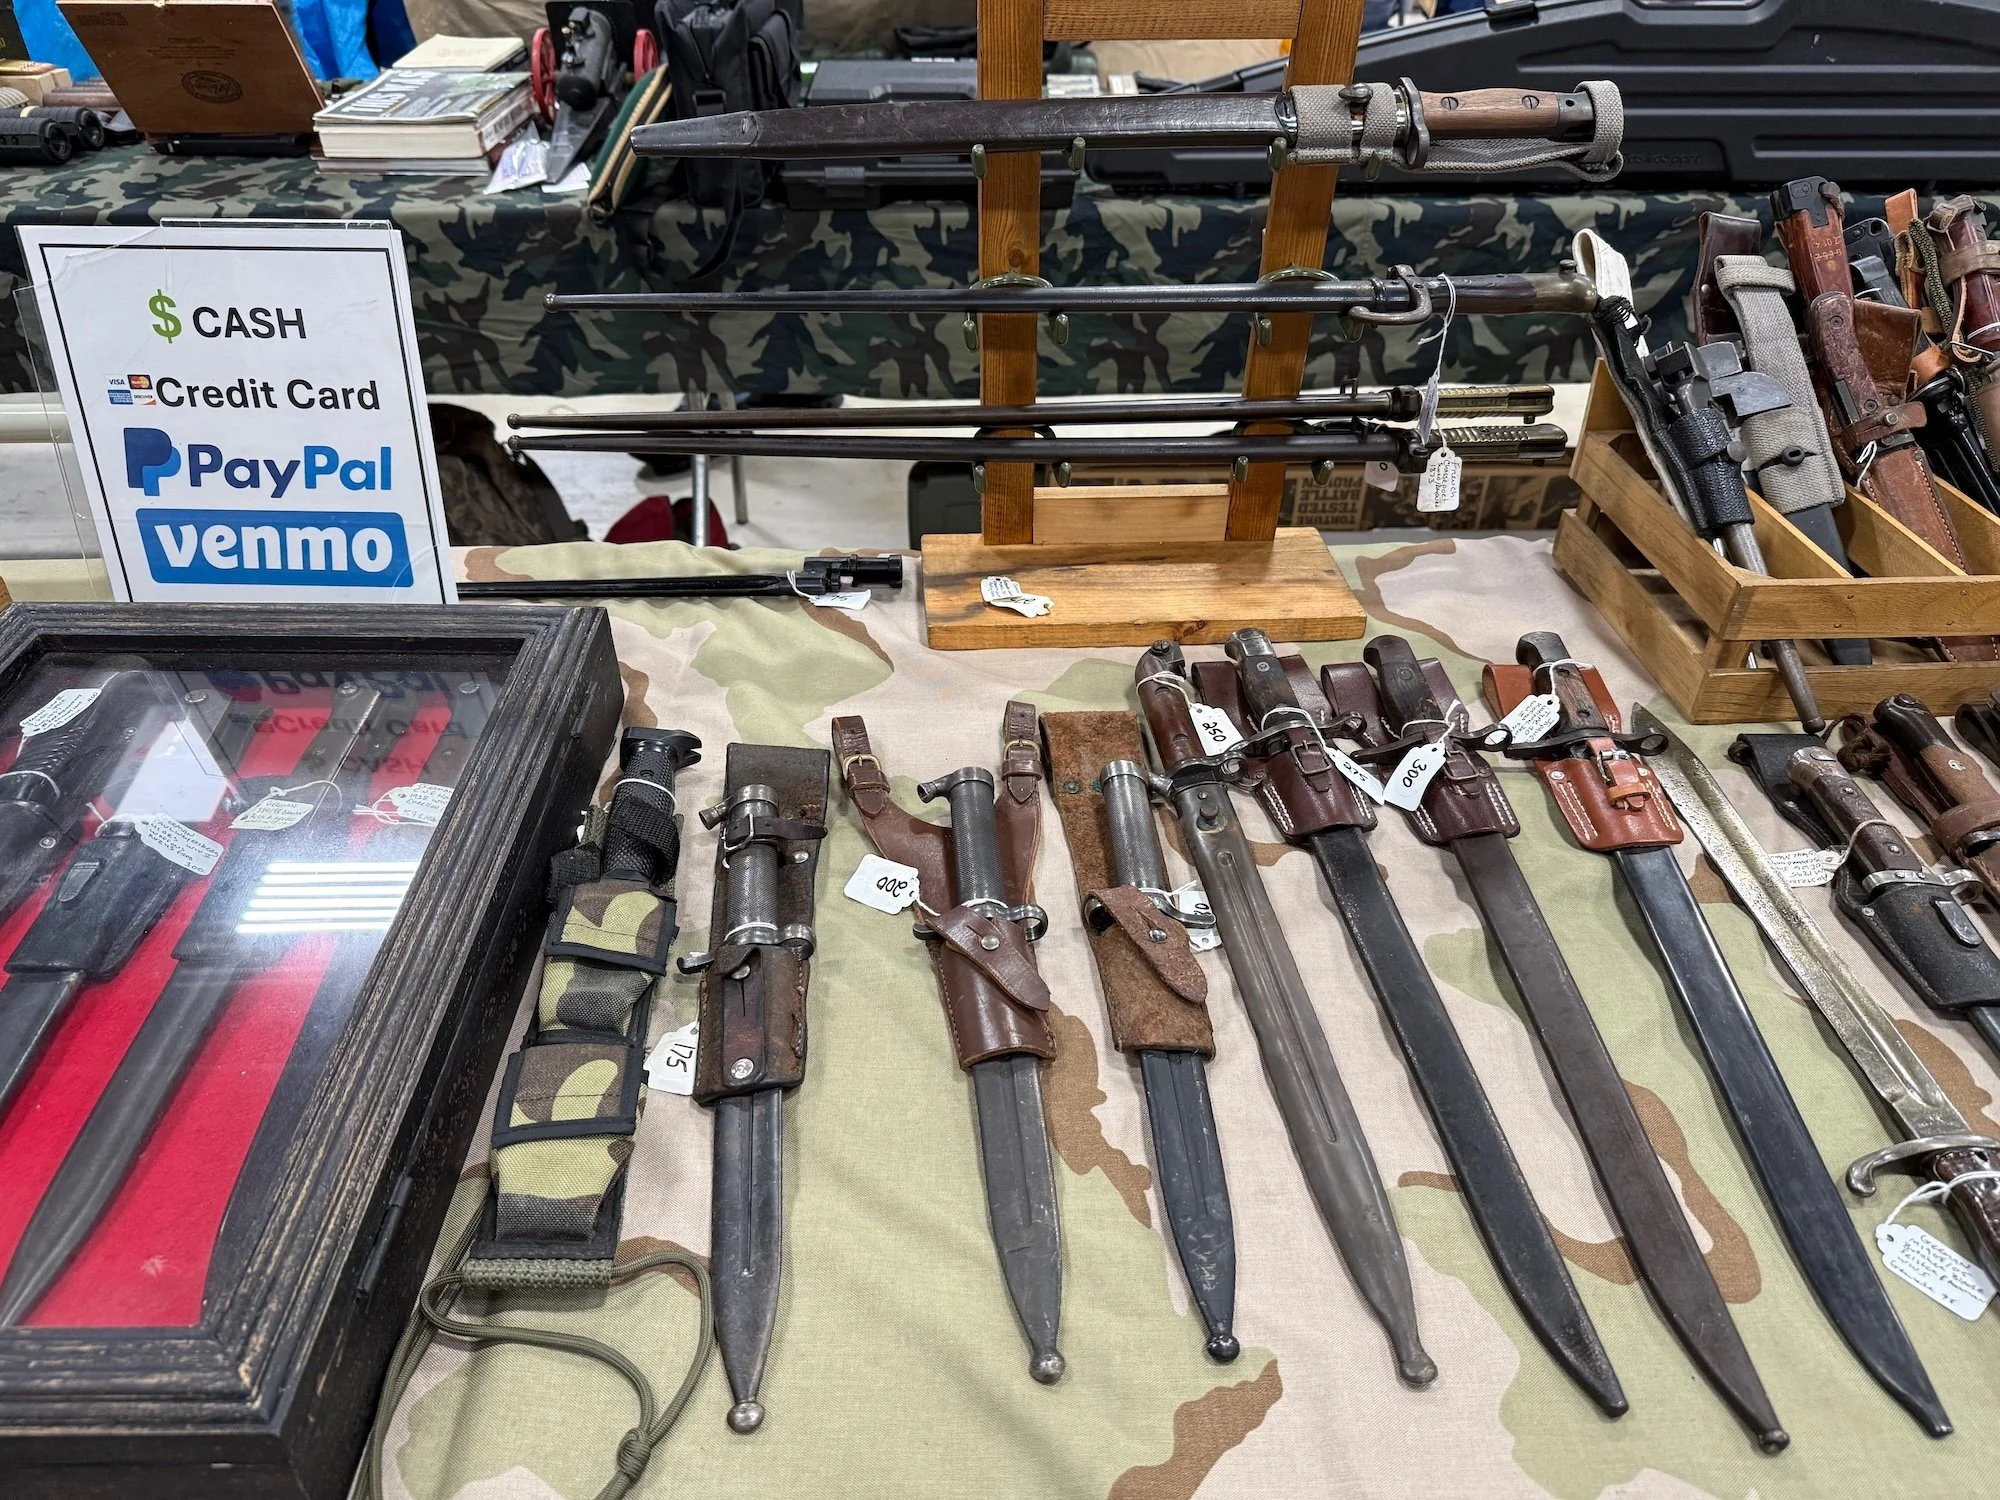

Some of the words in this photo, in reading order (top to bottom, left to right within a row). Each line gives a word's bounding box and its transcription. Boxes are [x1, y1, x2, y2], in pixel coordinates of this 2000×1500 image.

[148, 288, 182, 344] $
[193, 306, 307, 339] CASH
[156, 377, 278, 410] Credit
[287, 379, 381, 410] Card
[188, 443, 392, 499] PayPal
[154, 524, 393, 573] venmo
[1202, 721, 1227, 742] 250
[1402, 759, 1427, 788] 300
[876, 876, 908, 898] 200
[666, 1043, 696, 1073] 175
